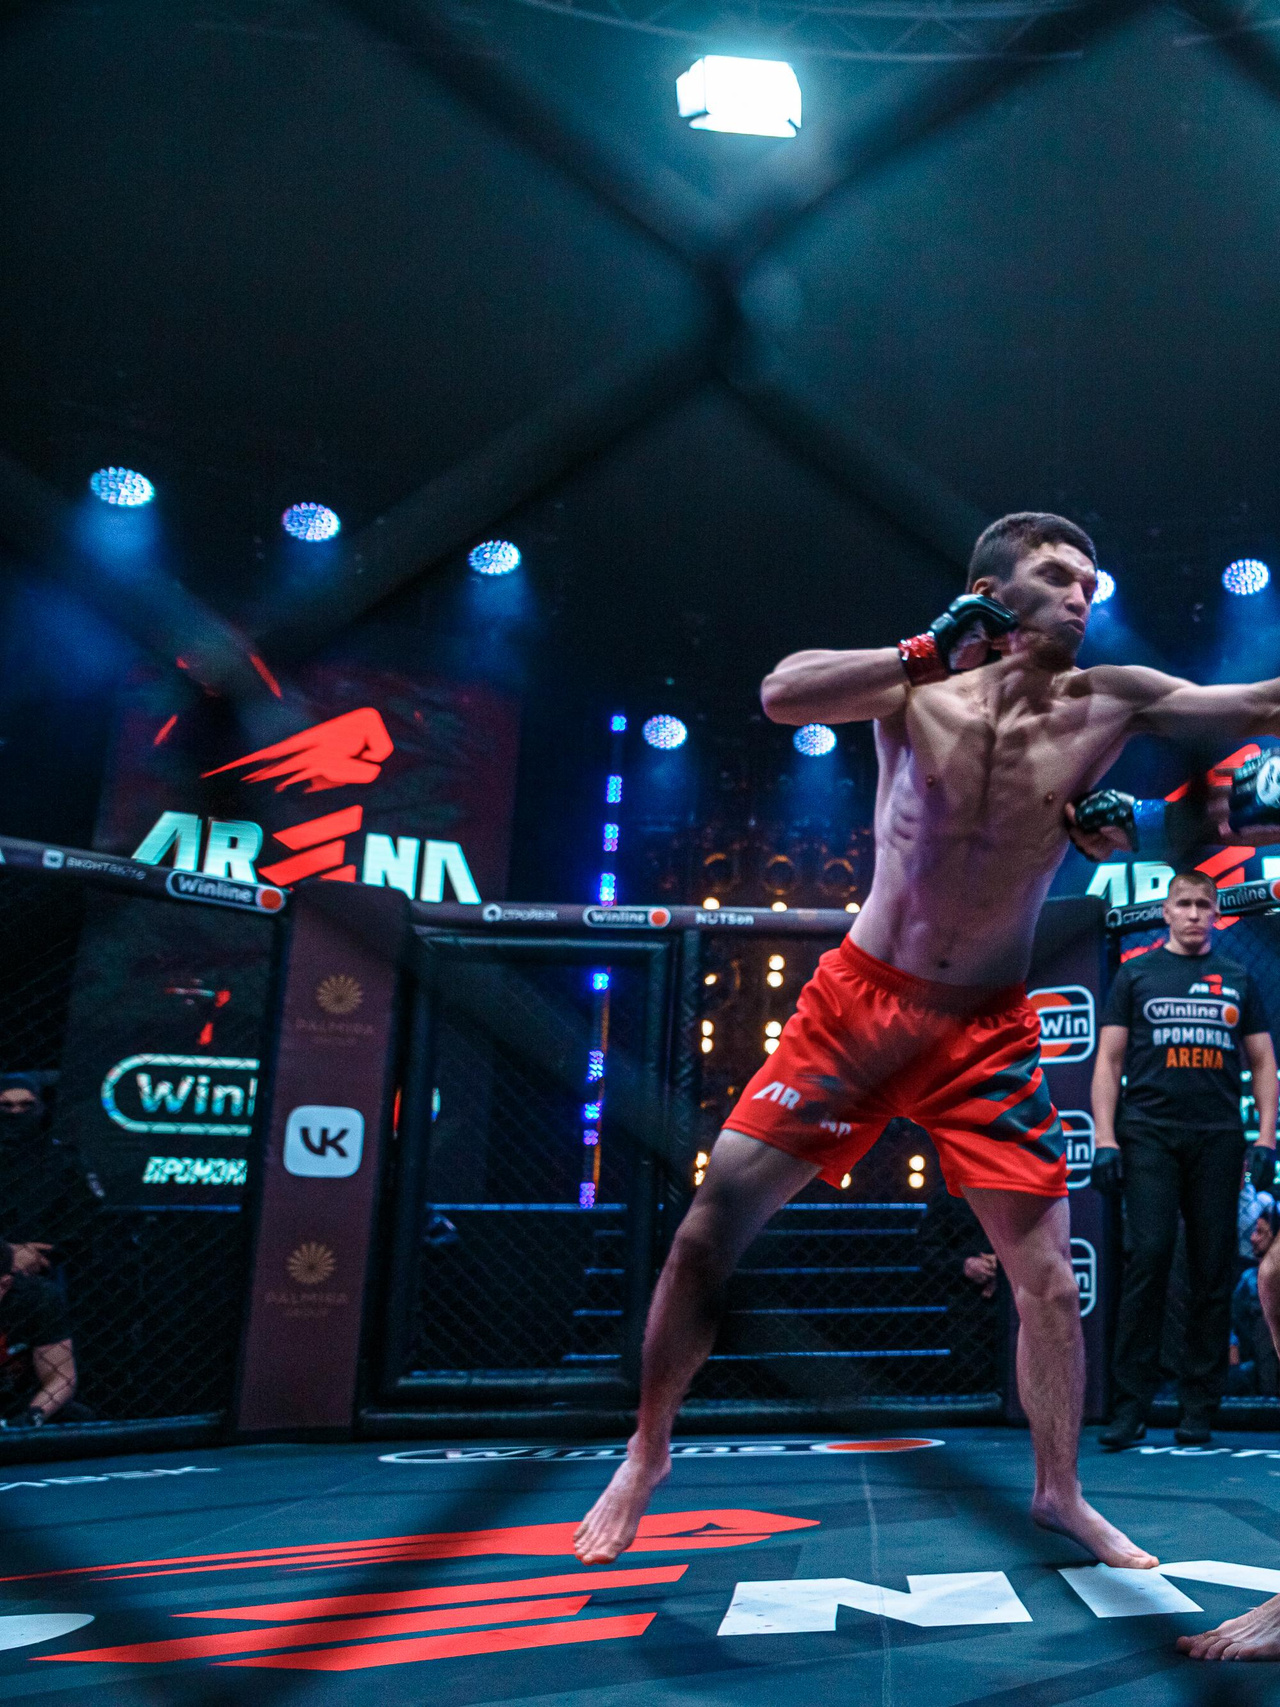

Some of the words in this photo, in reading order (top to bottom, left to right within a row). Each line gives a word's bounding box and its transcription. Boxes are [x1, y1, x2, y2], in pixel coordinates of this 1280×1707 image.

[178, 875, 253, 903] Winline
[591, 912, 646, 924] Winline
[1151, 1002, 1219, 1019] Winline
[1040, 1014, 1088, 1036] Win
[1166, 1047, 1224, 1070] ARENA
[136, 1072, 258, 1117] Winl
[299, 1127, 349, 1158] VK
[1066, 1140, 1089, 1161] in
